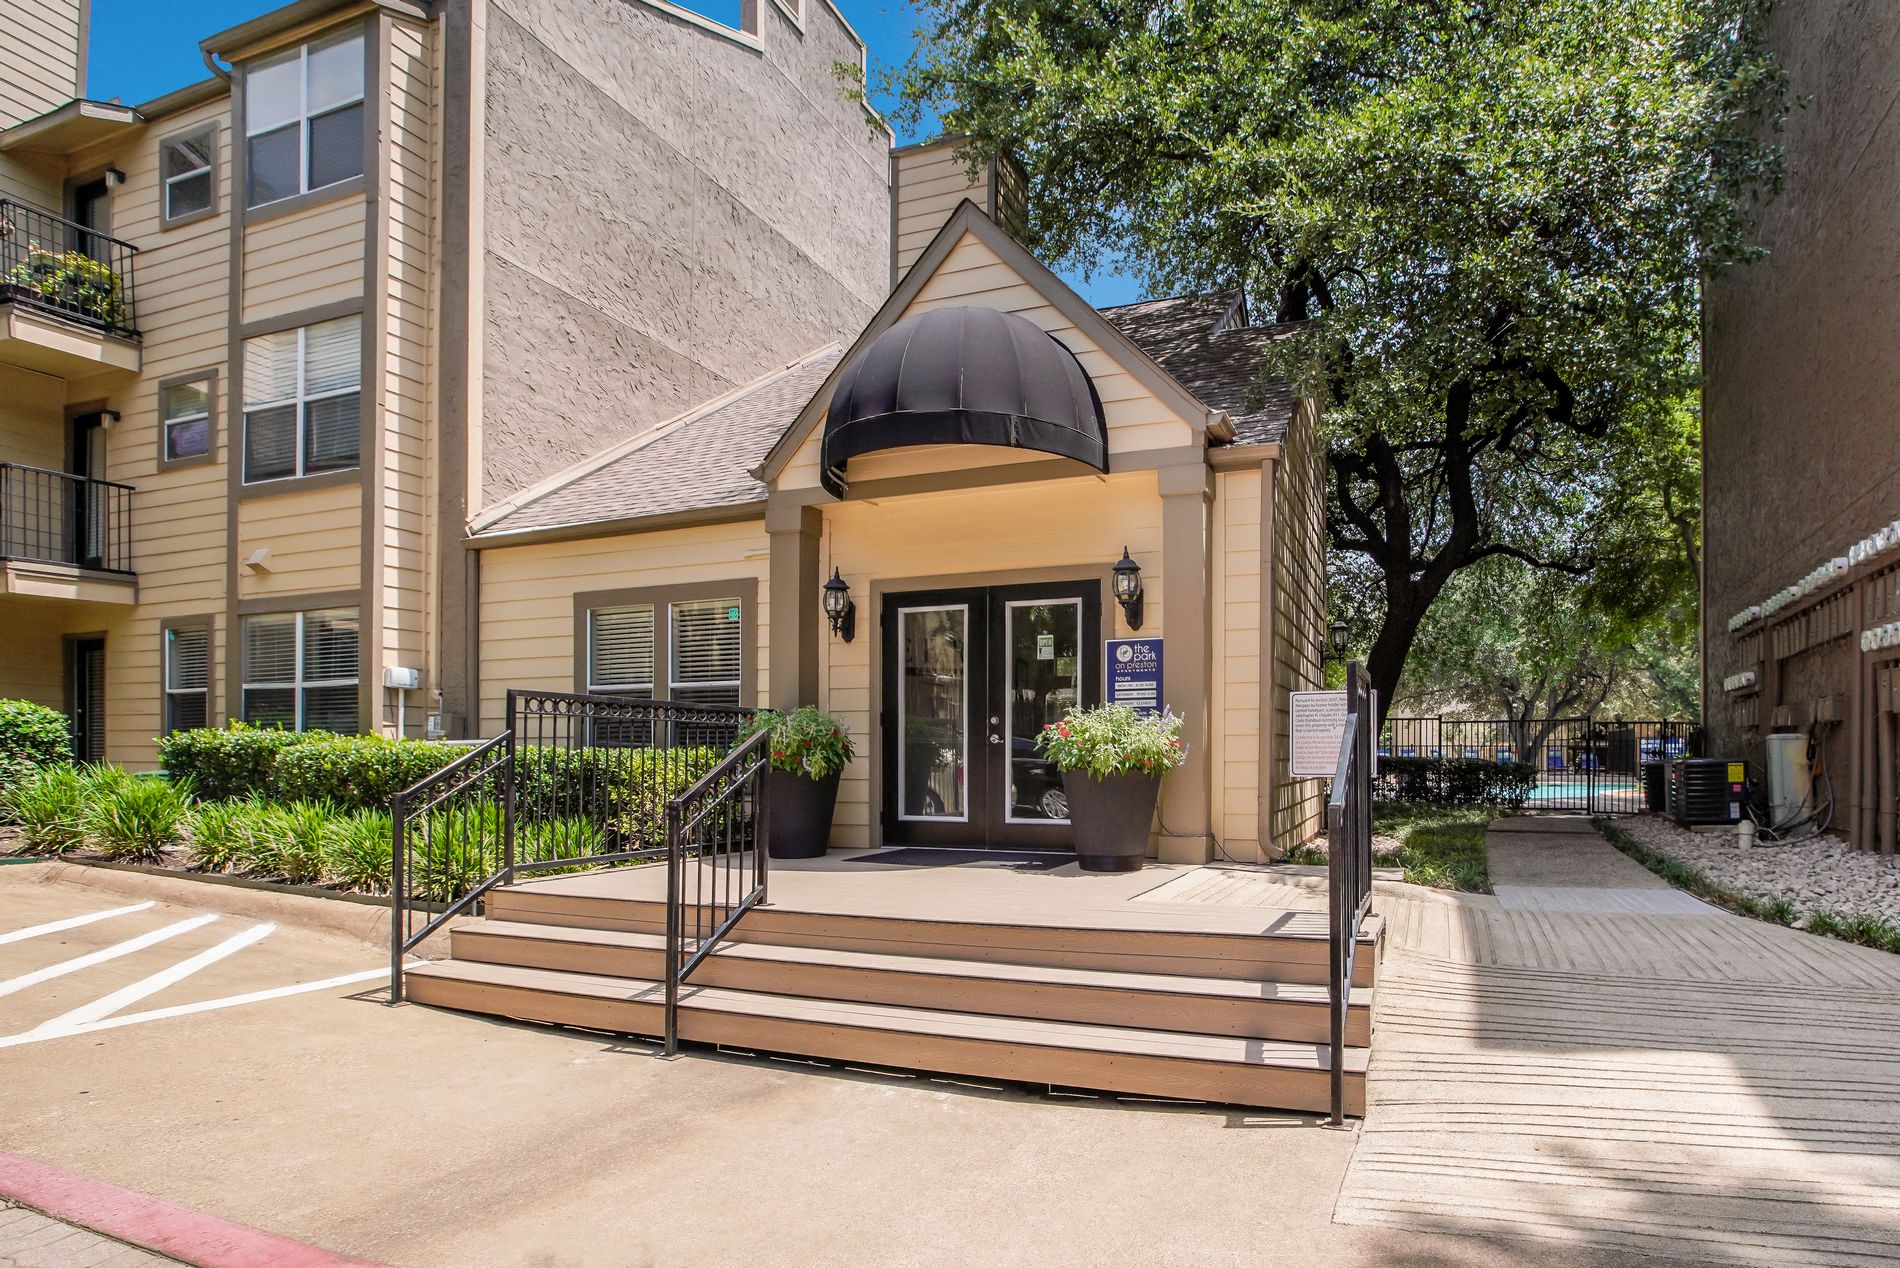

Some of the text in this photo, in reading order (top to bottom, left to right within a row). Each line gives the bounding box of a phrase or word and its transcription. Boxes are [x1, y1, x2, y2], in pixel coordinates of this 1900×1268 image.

[1134, 643, 1150, 653] the
[1134, 651, 1157, 662] park
[1127, 661, 1157, 670] preston
